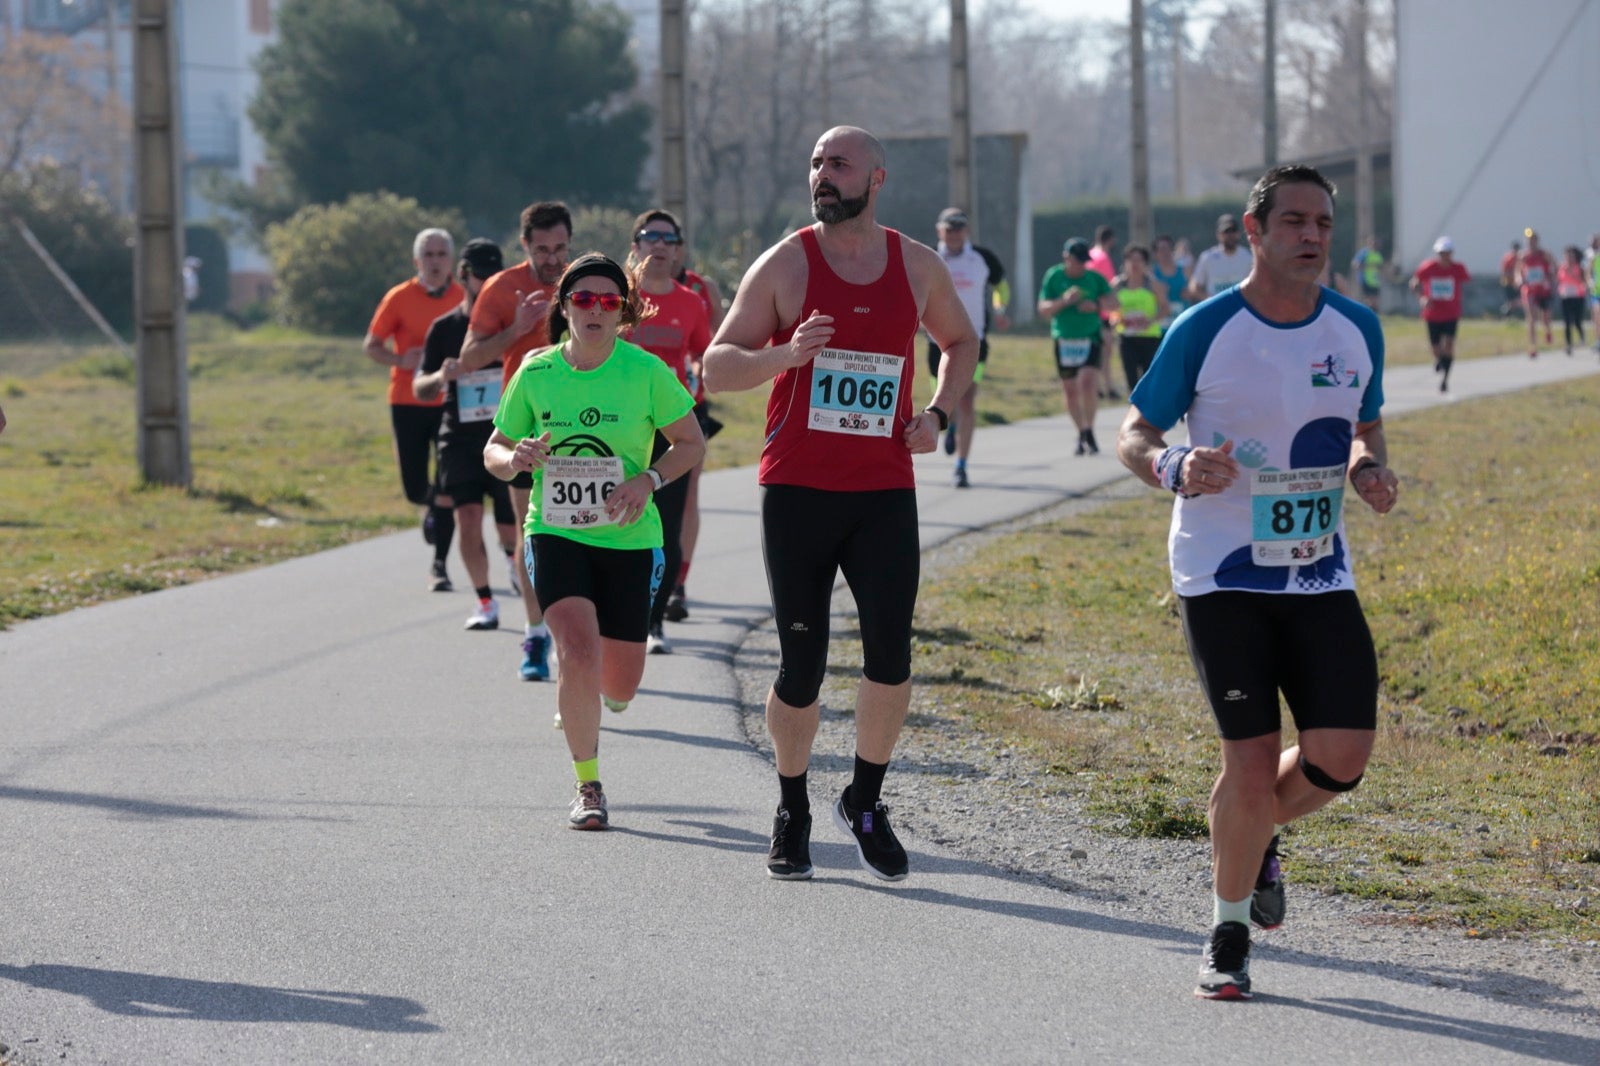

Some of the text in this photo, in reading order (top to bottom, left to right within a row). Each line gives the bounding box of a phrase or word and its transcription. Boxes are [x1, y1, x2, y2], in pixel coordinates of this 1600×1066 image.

[838, 352, 853, 361] GRAN
[854, 354, 874, 363] PREMIO
[874, 356, 882, 364] DE
[882, 356, 899, 366] FONDO
[844, 362, 877, 373] DIPUTACIÓN
[475, 386, 486, 404] 7
[818, 374, 895, 410] 1066
[1279, 472, 1297, 483] GRAN
[1298, 470, 1320, 480] PREMIO
[1321, 470, 1328, 479] DE
[552, 481, 616, 505] 3016
[1271, 496, 1331, 534] 878
